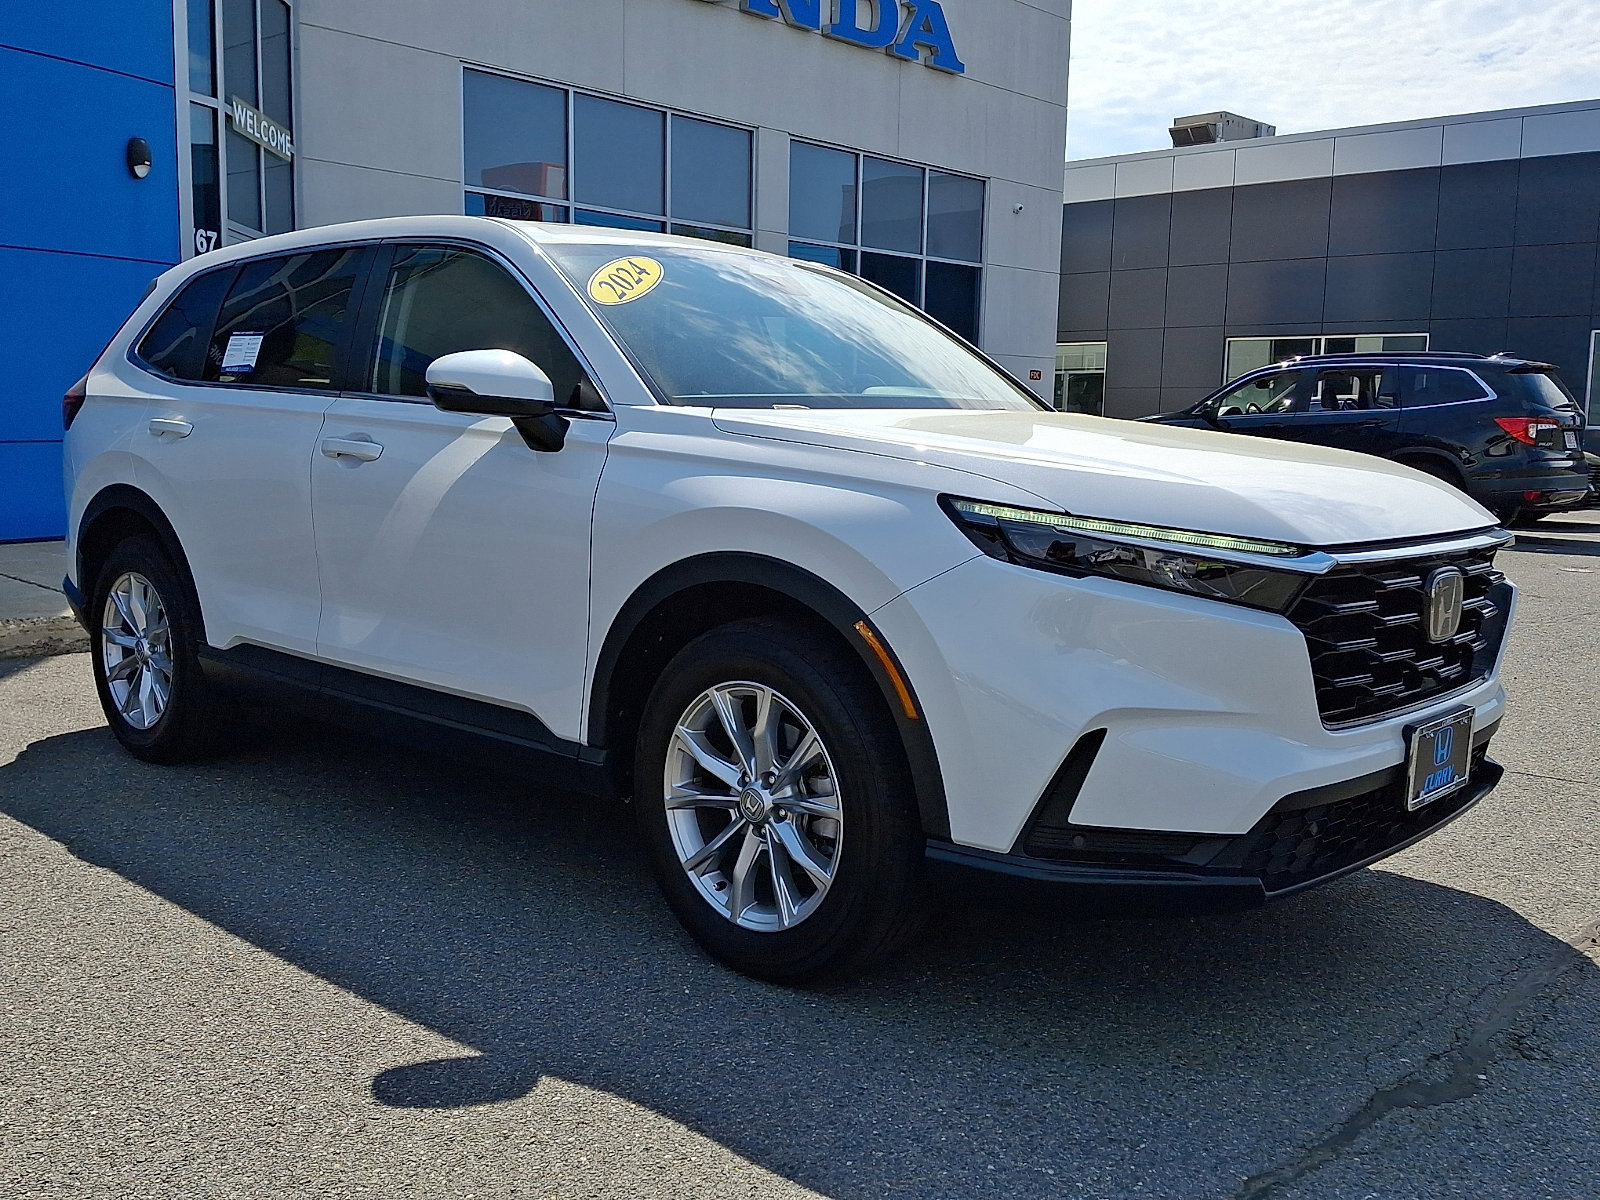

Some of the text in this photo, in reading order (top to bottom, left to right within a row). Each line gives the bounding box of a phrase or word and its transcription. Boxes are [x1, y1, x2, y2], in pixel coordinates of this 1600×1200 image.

[232, 101, 291, 156] WELCOME
[598, 260, 651, 300] 2024
[1424, 765, 1454, 791] CURRY
